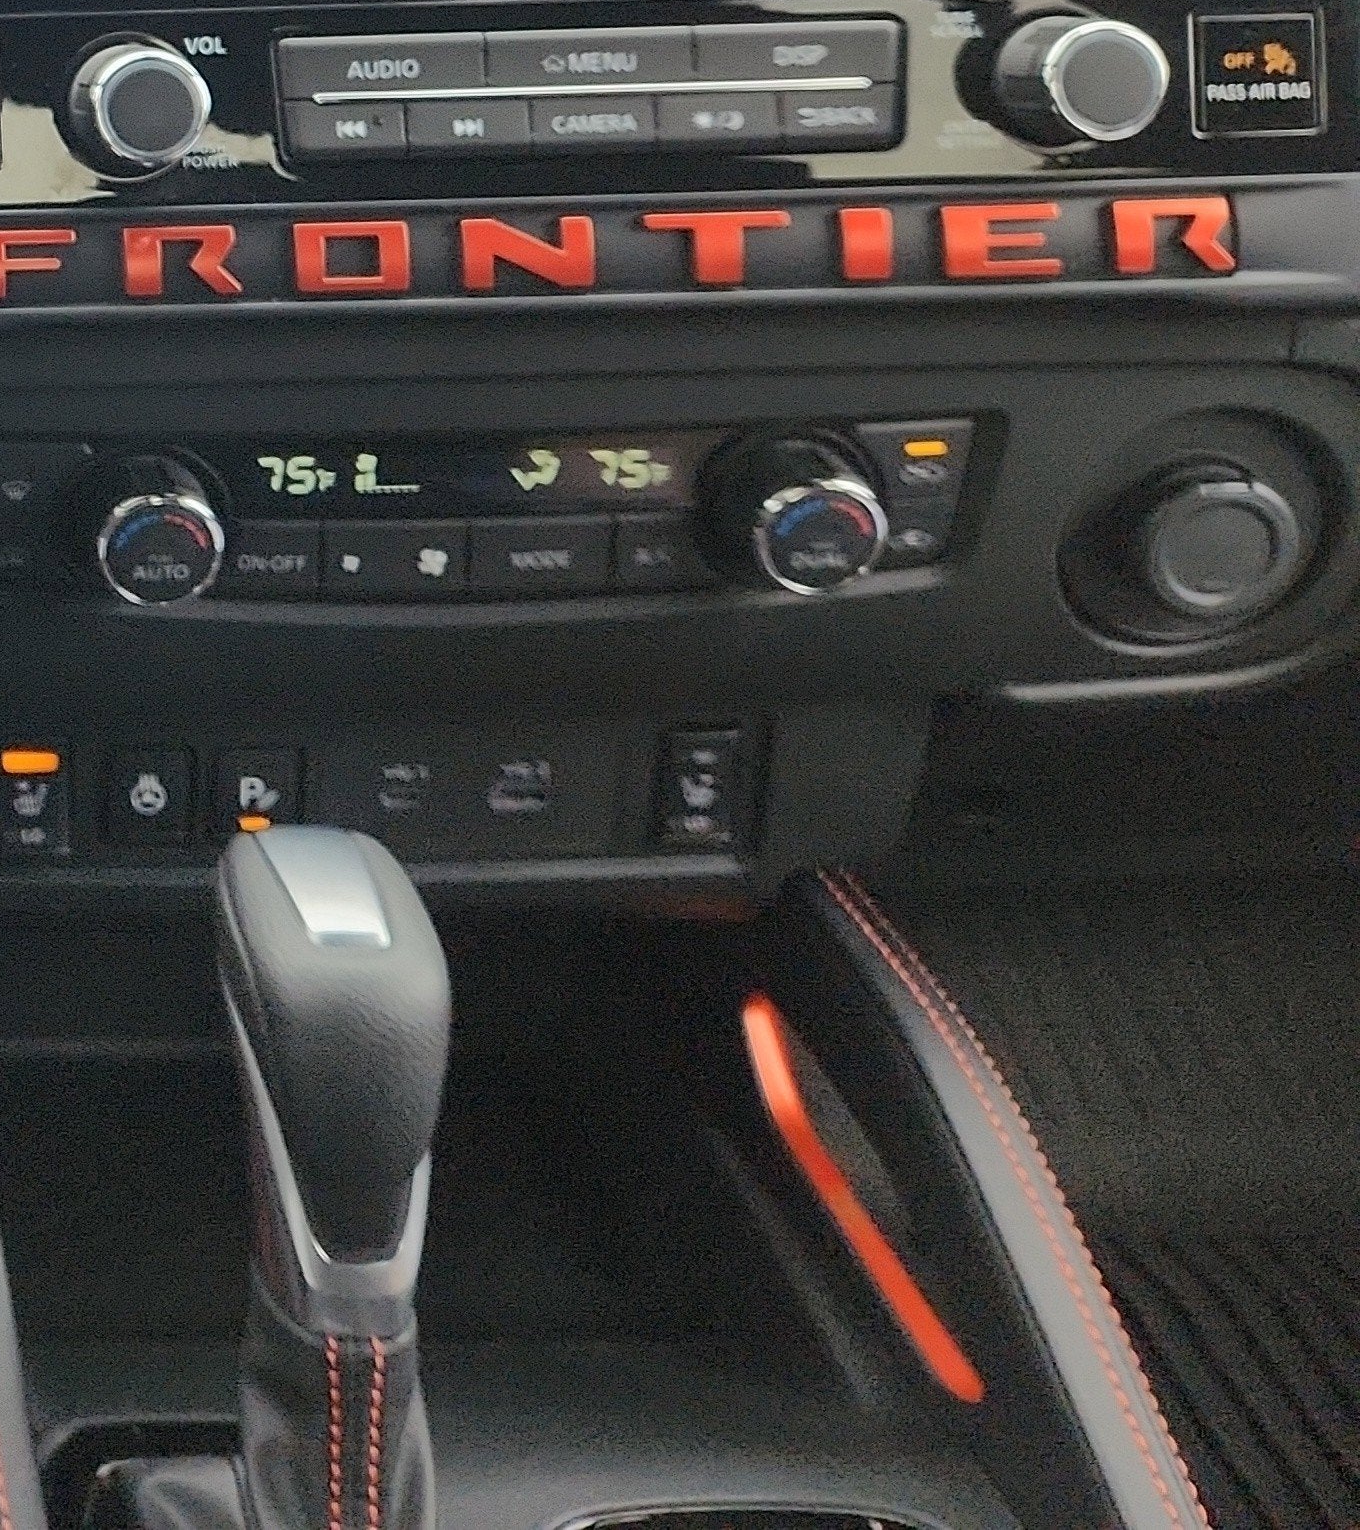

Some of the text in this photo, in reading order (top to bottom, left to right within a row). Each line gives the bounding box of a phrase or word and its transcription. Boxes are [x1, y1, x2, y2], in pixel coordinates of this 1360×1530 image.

[183, 36, 228, 56] VOL
[346, 57, 421, 81] AUDIO
[567, 51, 638, 73] MENU
[1222, 51, 1256, 70] OFF
[1206, 81, 1312, 103] PASS AIR BAG
[551, 114, 638, 134] CAMERA
